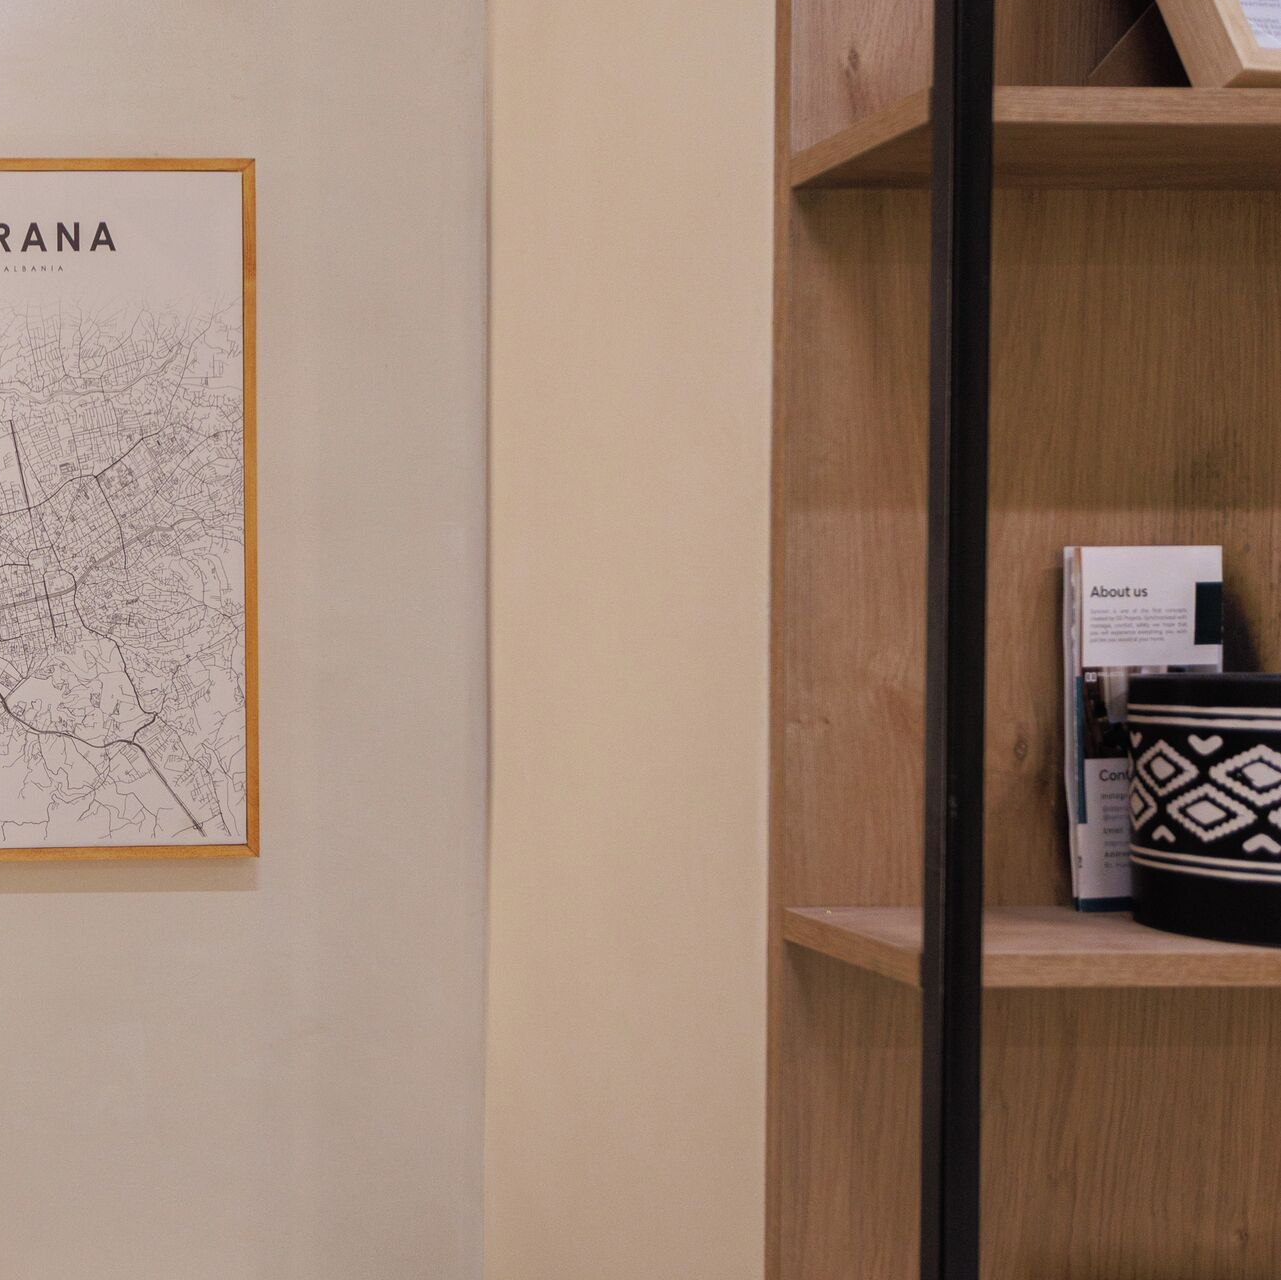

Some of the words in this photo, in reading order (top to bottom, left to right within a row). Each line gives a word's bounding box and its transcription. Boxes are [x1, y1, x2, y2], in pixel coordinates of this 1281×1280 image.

[1090, 585, 1131, 598] About
[1133, 587, 1148, 598] us
[1099, 769, 1130, 782] Cont
